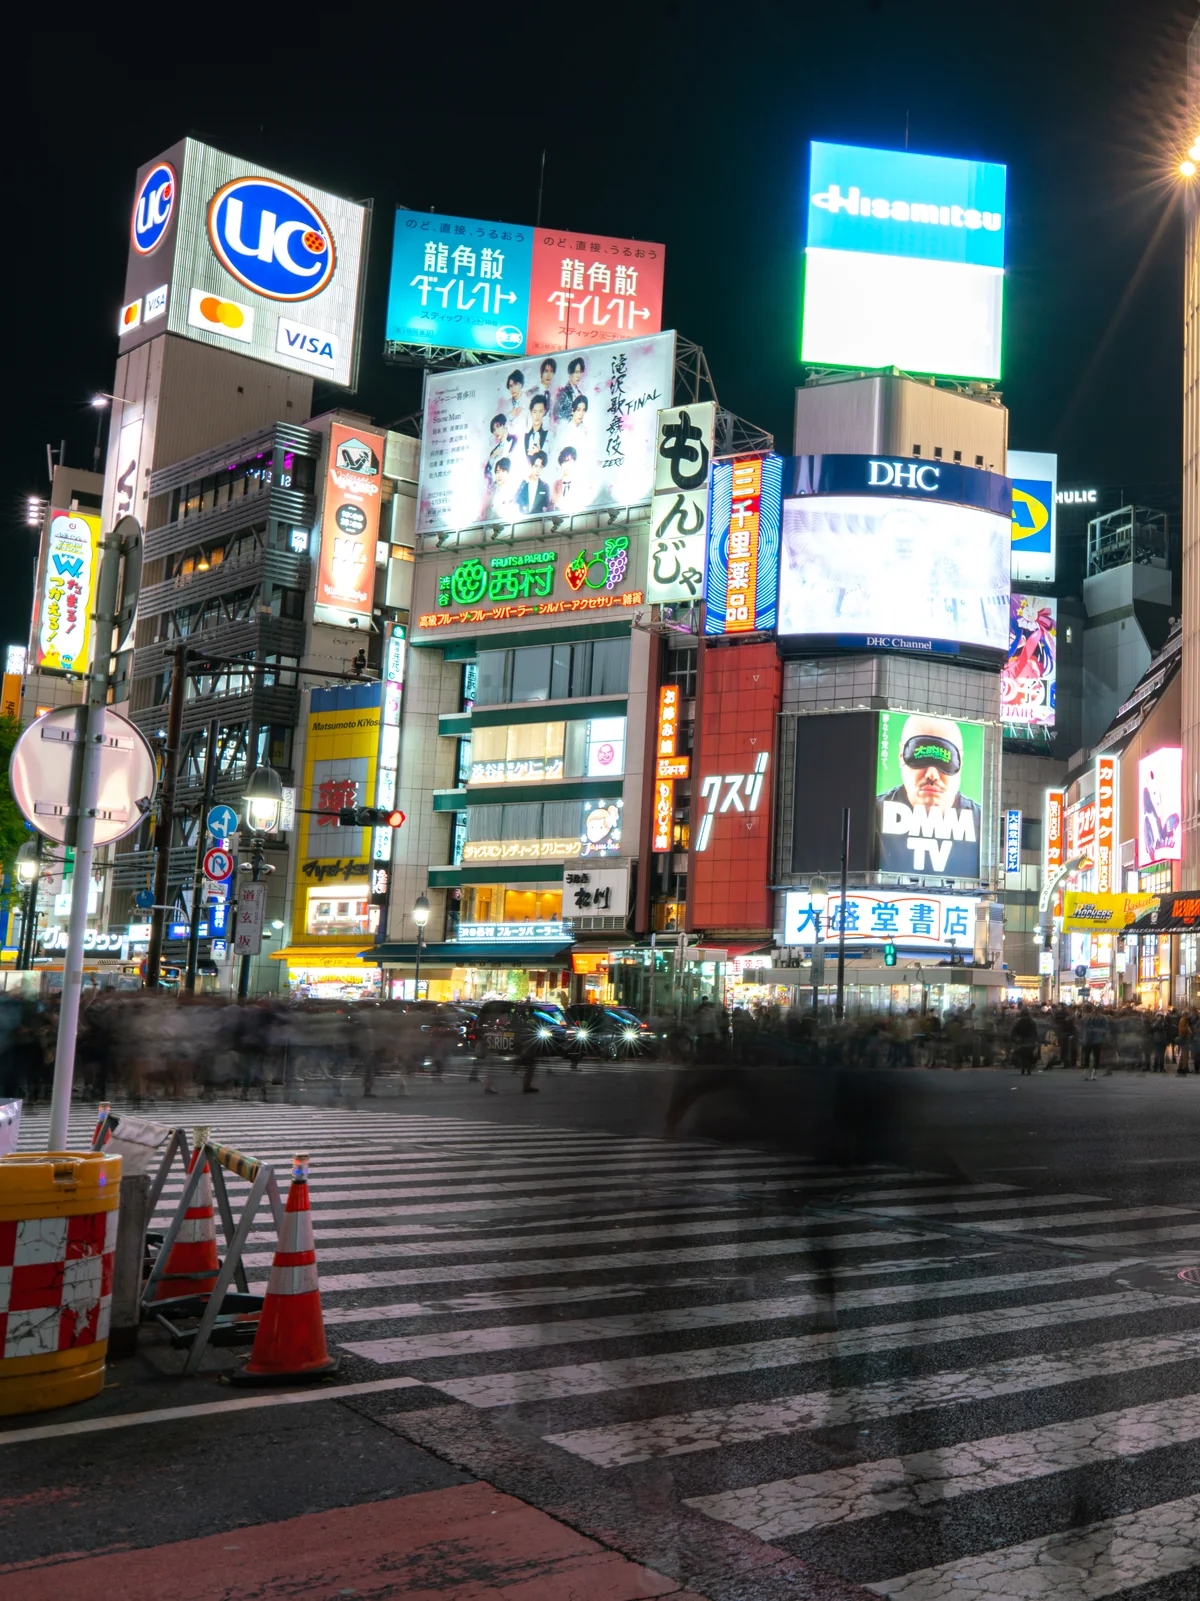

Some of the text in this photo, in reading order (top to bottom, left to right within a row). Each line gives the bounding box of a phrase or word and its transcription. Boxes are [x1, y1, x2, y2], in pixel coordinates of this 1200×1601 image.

[136, 186, 171, 235] UC
[811, 184, 1001, 231] Hisamitsu
[225, 196, 322, 277] UC
[405, 219, 525, 243] のど、直接、うるおう
[423, 241, 505, 280] 龍角散
[543, 237, 658, 260] のど、直接、うるおう
[410, 274, 518, 314] ダイレクト
[560, 258, 638, 297] 龍角散
[147, 293, 166, 312] VISA
[420, 311, 463, 323] スティック
[547, 291, 650, 329] ダイレクト
[284, 328, 334, 360] VISA
[558, 327, 599, 338] スティック
[448, 413, 462, 421] Man
[602, 354, 628, 469] 滝沢歌舞伎 ZERO
[625, 392, 662, 416] FINAL
[868, 460, 940, 491] DHC
[651, 410, 708, 596] もんじゃ
[1055, 489, 1097, 503] HULIC
[490, 551, 556, 568] FRUITS&PARLOR
[725, 467, 756, 622] 三千里薬品
[437, 564, 555, 607] 渋谷 西村
[866, 636, 933, 651] DHC Channel
[312, 719, 357, 732] Matsumoto
[316, 779, 360, 828] 薬
[1099, 767, 1113, 838] カラオケ
[882, 801, 976, 842] DMM
[581, 843, 621, 857] Jasmine
[907, 837, 953, 872] TV
[239, 889, 255, 948] 道玄坂
[797, 901, 969, 936] 大盛堂書店
[1072, 904, 1114, 921] ROCKERS
[43, 925, 124, 951] グルタウン
[486, 1035, 515, 1051] S.RIDE
